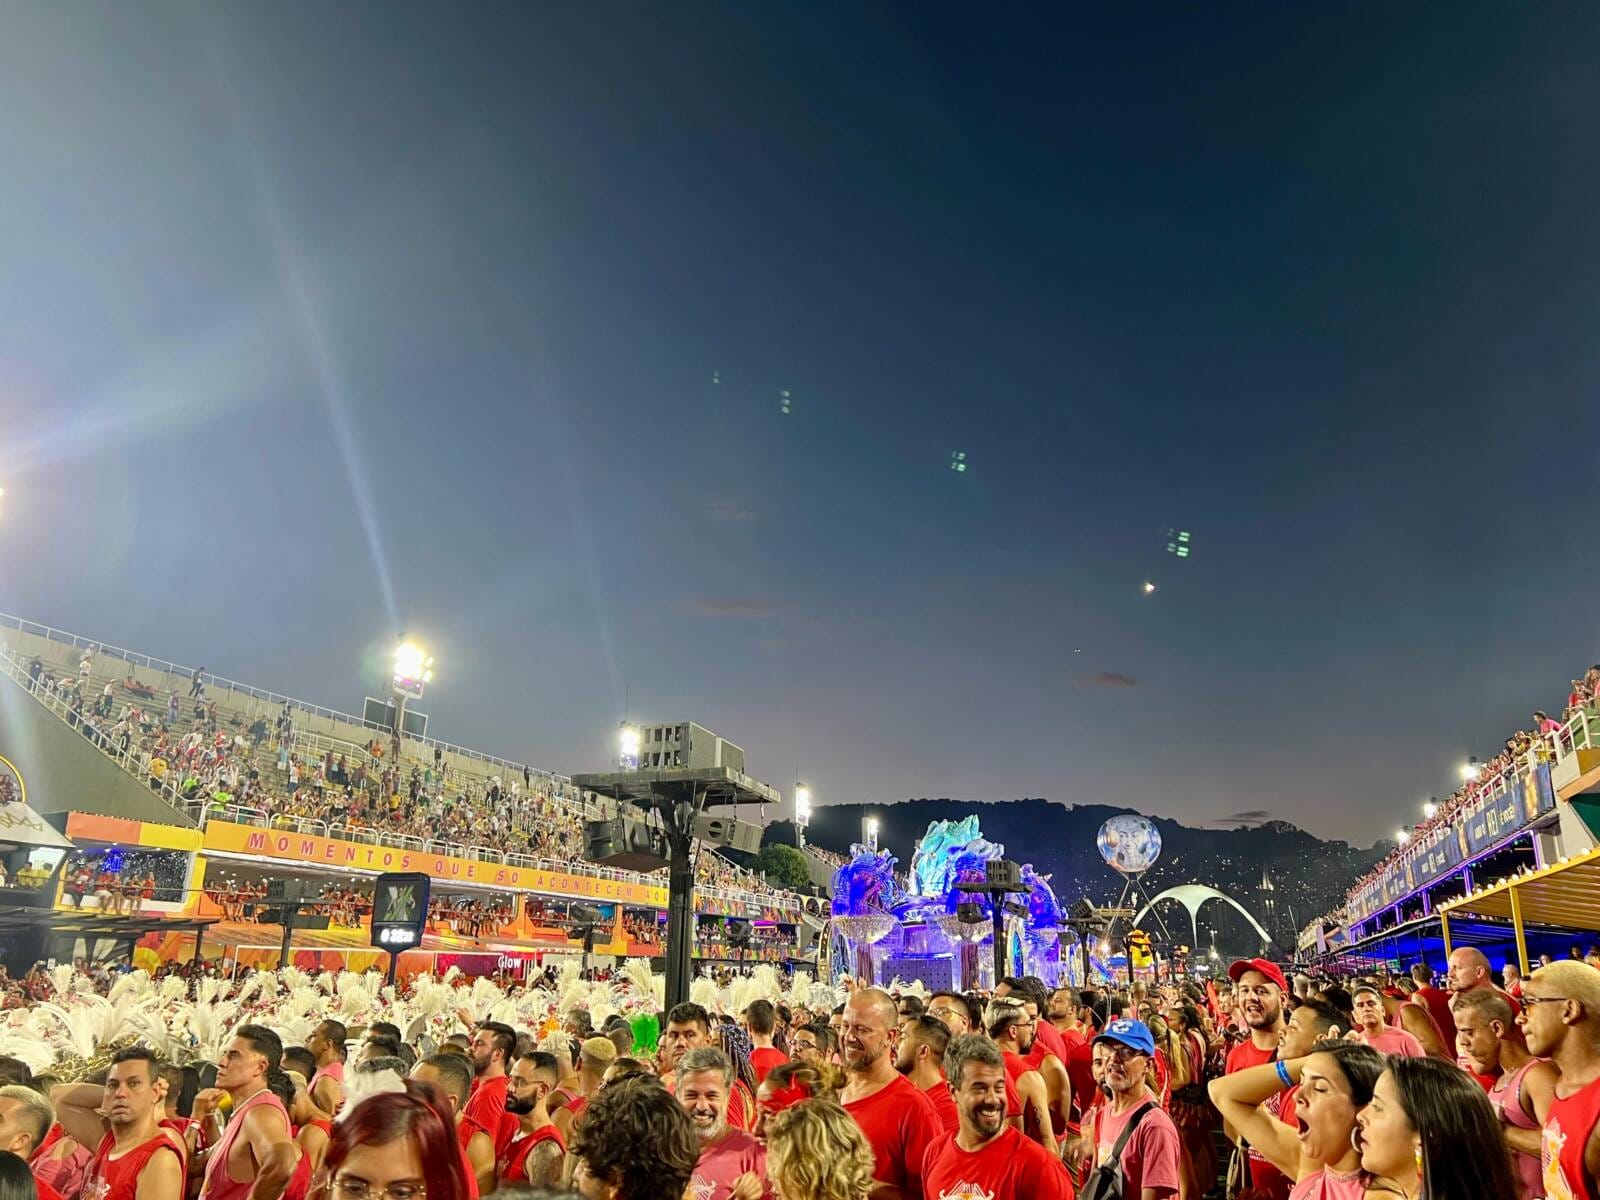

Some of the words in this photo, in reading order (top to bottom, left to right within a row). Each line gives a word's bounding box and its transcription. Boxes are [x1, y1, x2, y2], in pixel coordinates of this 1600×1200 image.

[249, 832, 411, 868] MOMENTOS
[435, 860, 475, 878] QUE
[536, 874, 632, 897] ACONTECEM
[497, 955, 521, 969] Glow
